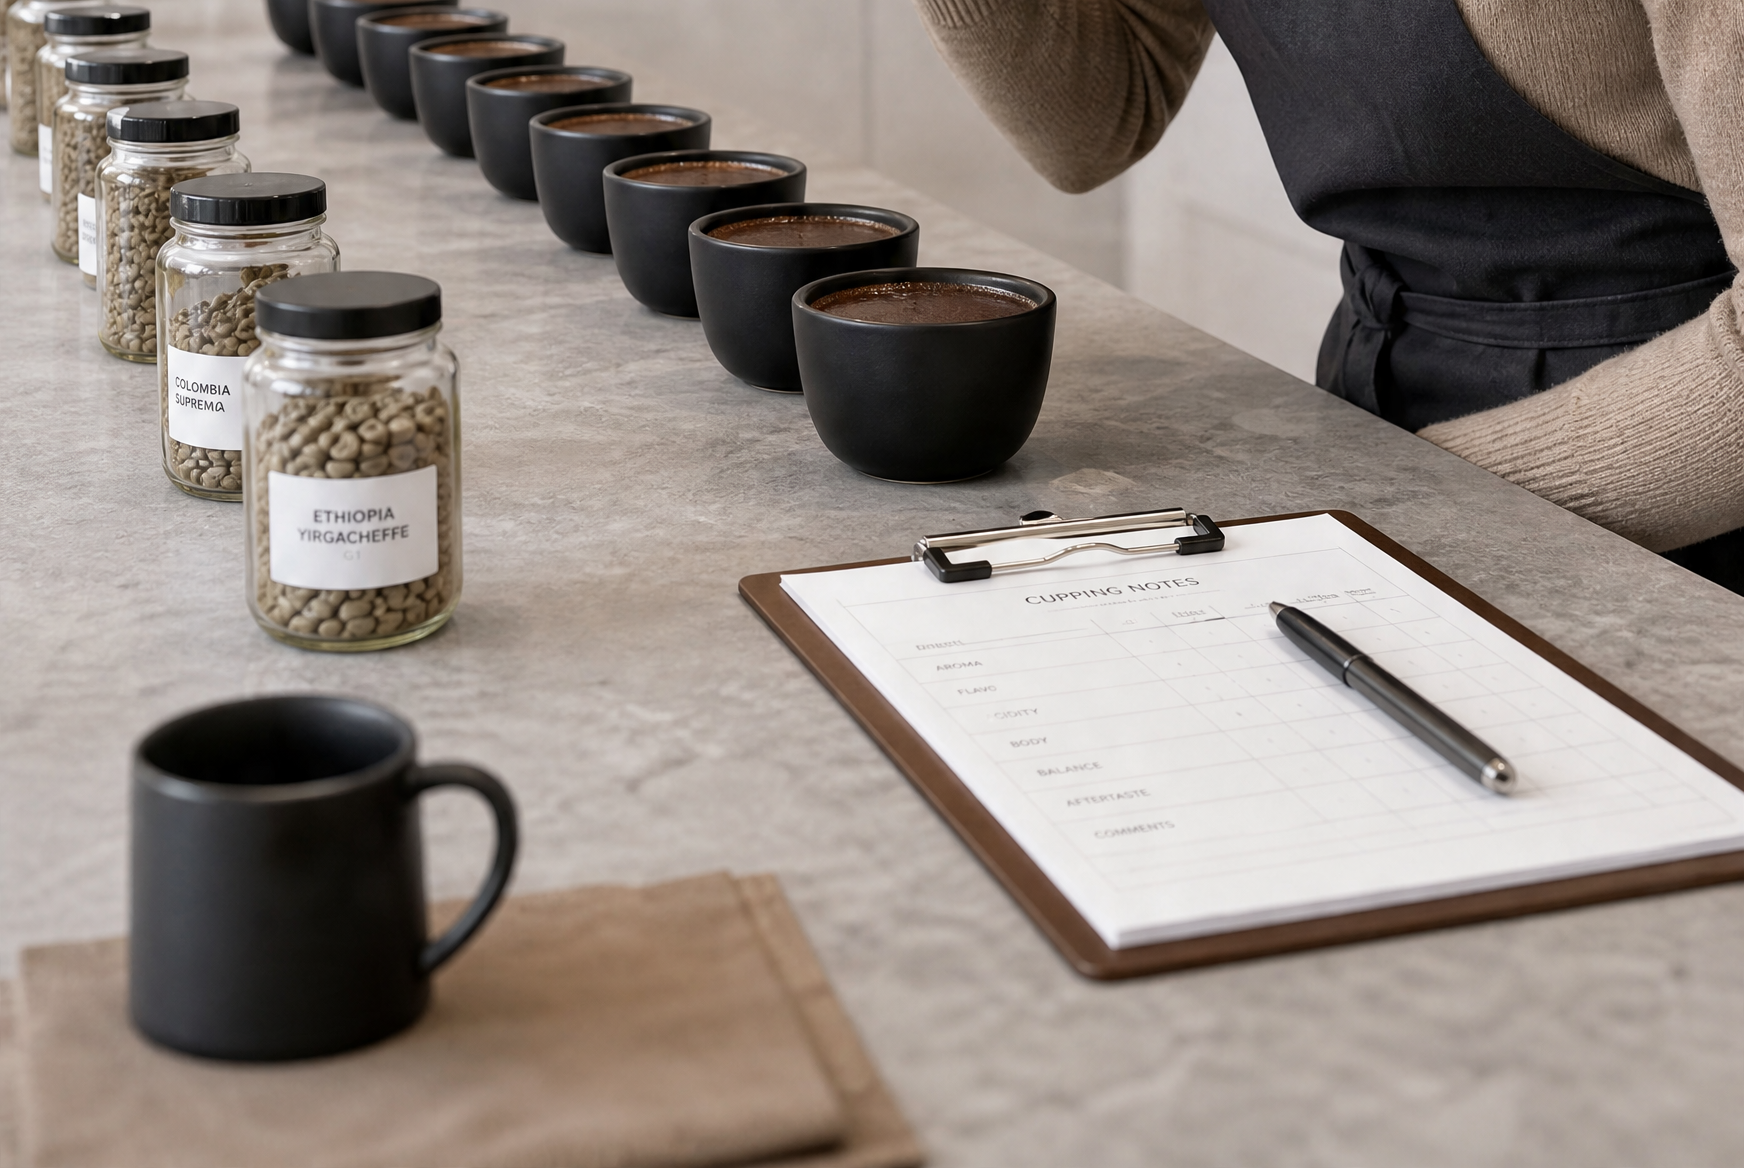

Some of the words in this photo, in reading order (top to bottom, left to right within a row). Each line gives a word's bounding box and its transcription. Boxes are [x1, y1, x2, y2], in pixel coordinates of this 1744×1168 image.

[175, 376, 231, 396] COLOMBIA
[313, 506, 395, 523] ETHIOPIA
[298, 525, 409, 544] YIRGACHEFFE
[1025, 586, 1123, 605] CUPPING
[1128, 577, 1200, 592] NOTES
[936, 660, 983, 671] AROMA
[987, 708, 1038, 720] CIDITY
[1009, 737, 1047, 748] BODY
[1036, 761, 1103, 777] BALANCE
[1067, 788, 1151, 807] AFTERTASTE
[1094, 820, 1175, 839] COMMENTS
